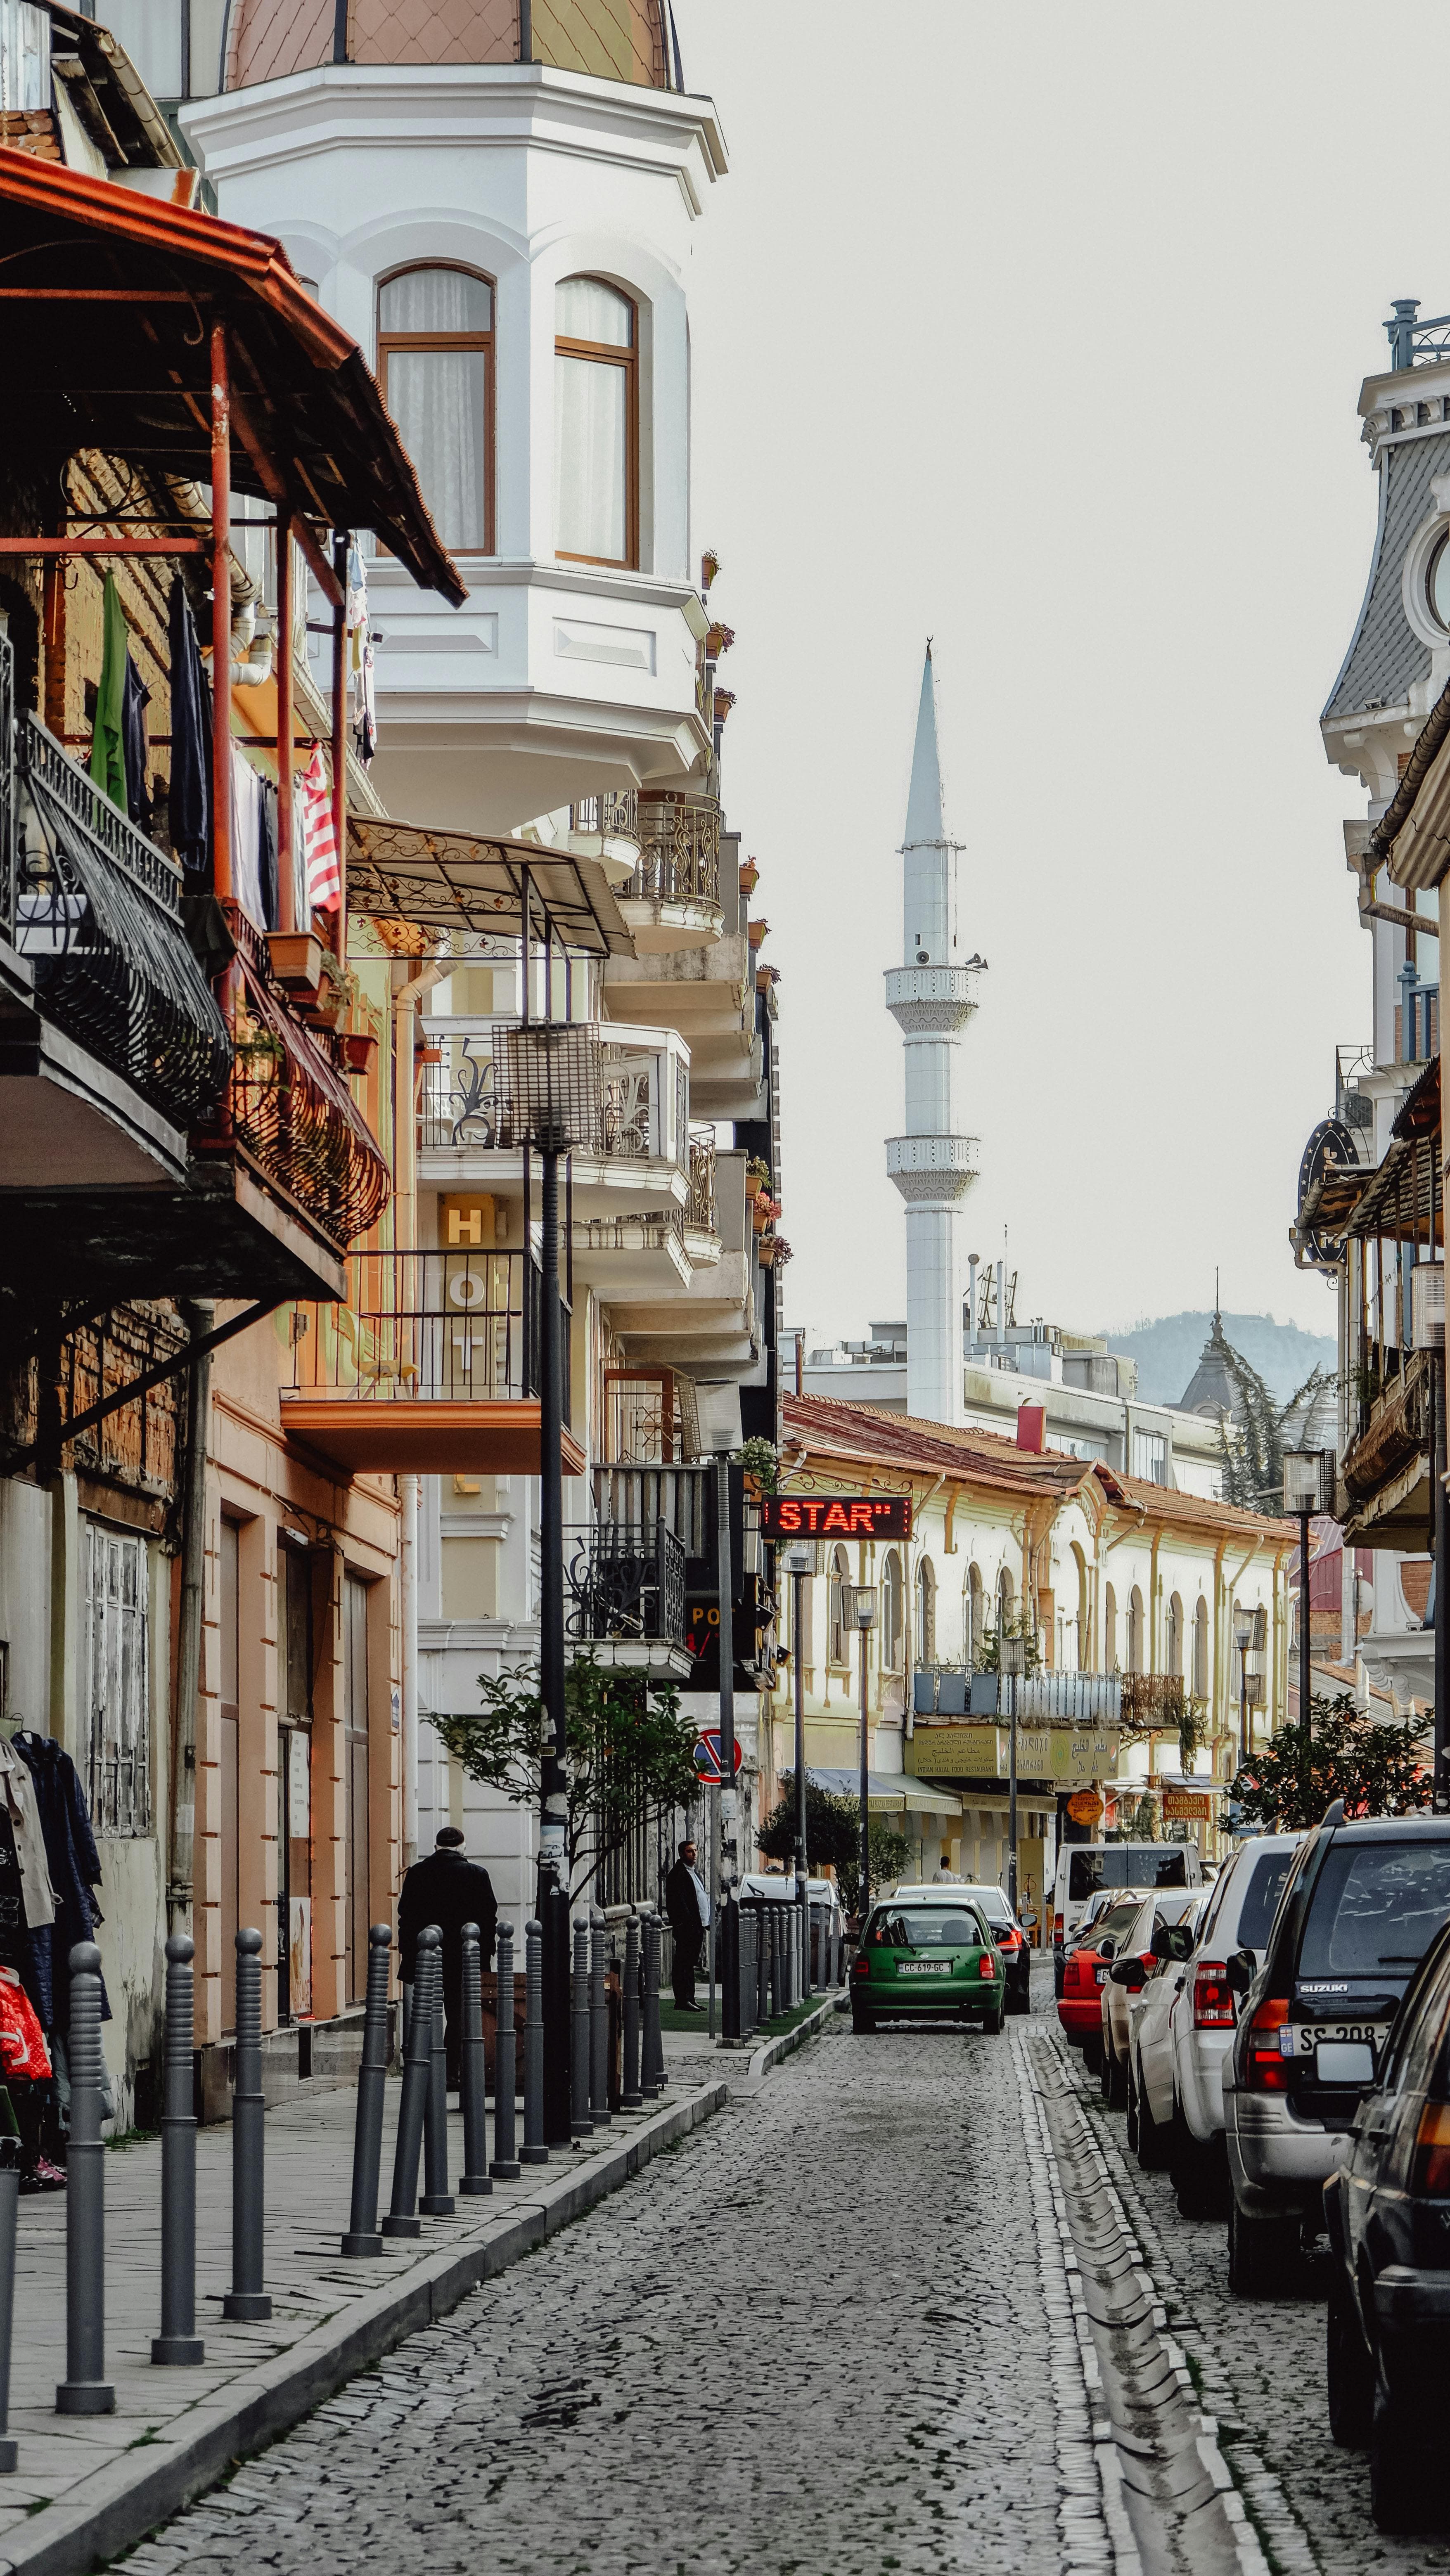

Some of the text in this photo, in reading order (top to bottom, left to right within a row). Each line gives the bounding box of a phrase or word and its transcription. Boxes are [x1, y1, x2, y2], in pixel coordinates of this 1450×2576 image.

[448, 1209, 485, 1494] HOTL
[1168, 1796, 1204, 1805] თამბაქო
[1165, 1807, 1207, 1816] სასმელები
[905, 1963, 943, 1972] CC-619-GC
[1301, 1984, 1348, 1993] SUZUKI
[1281, 2043, 1293, 2053] GE
